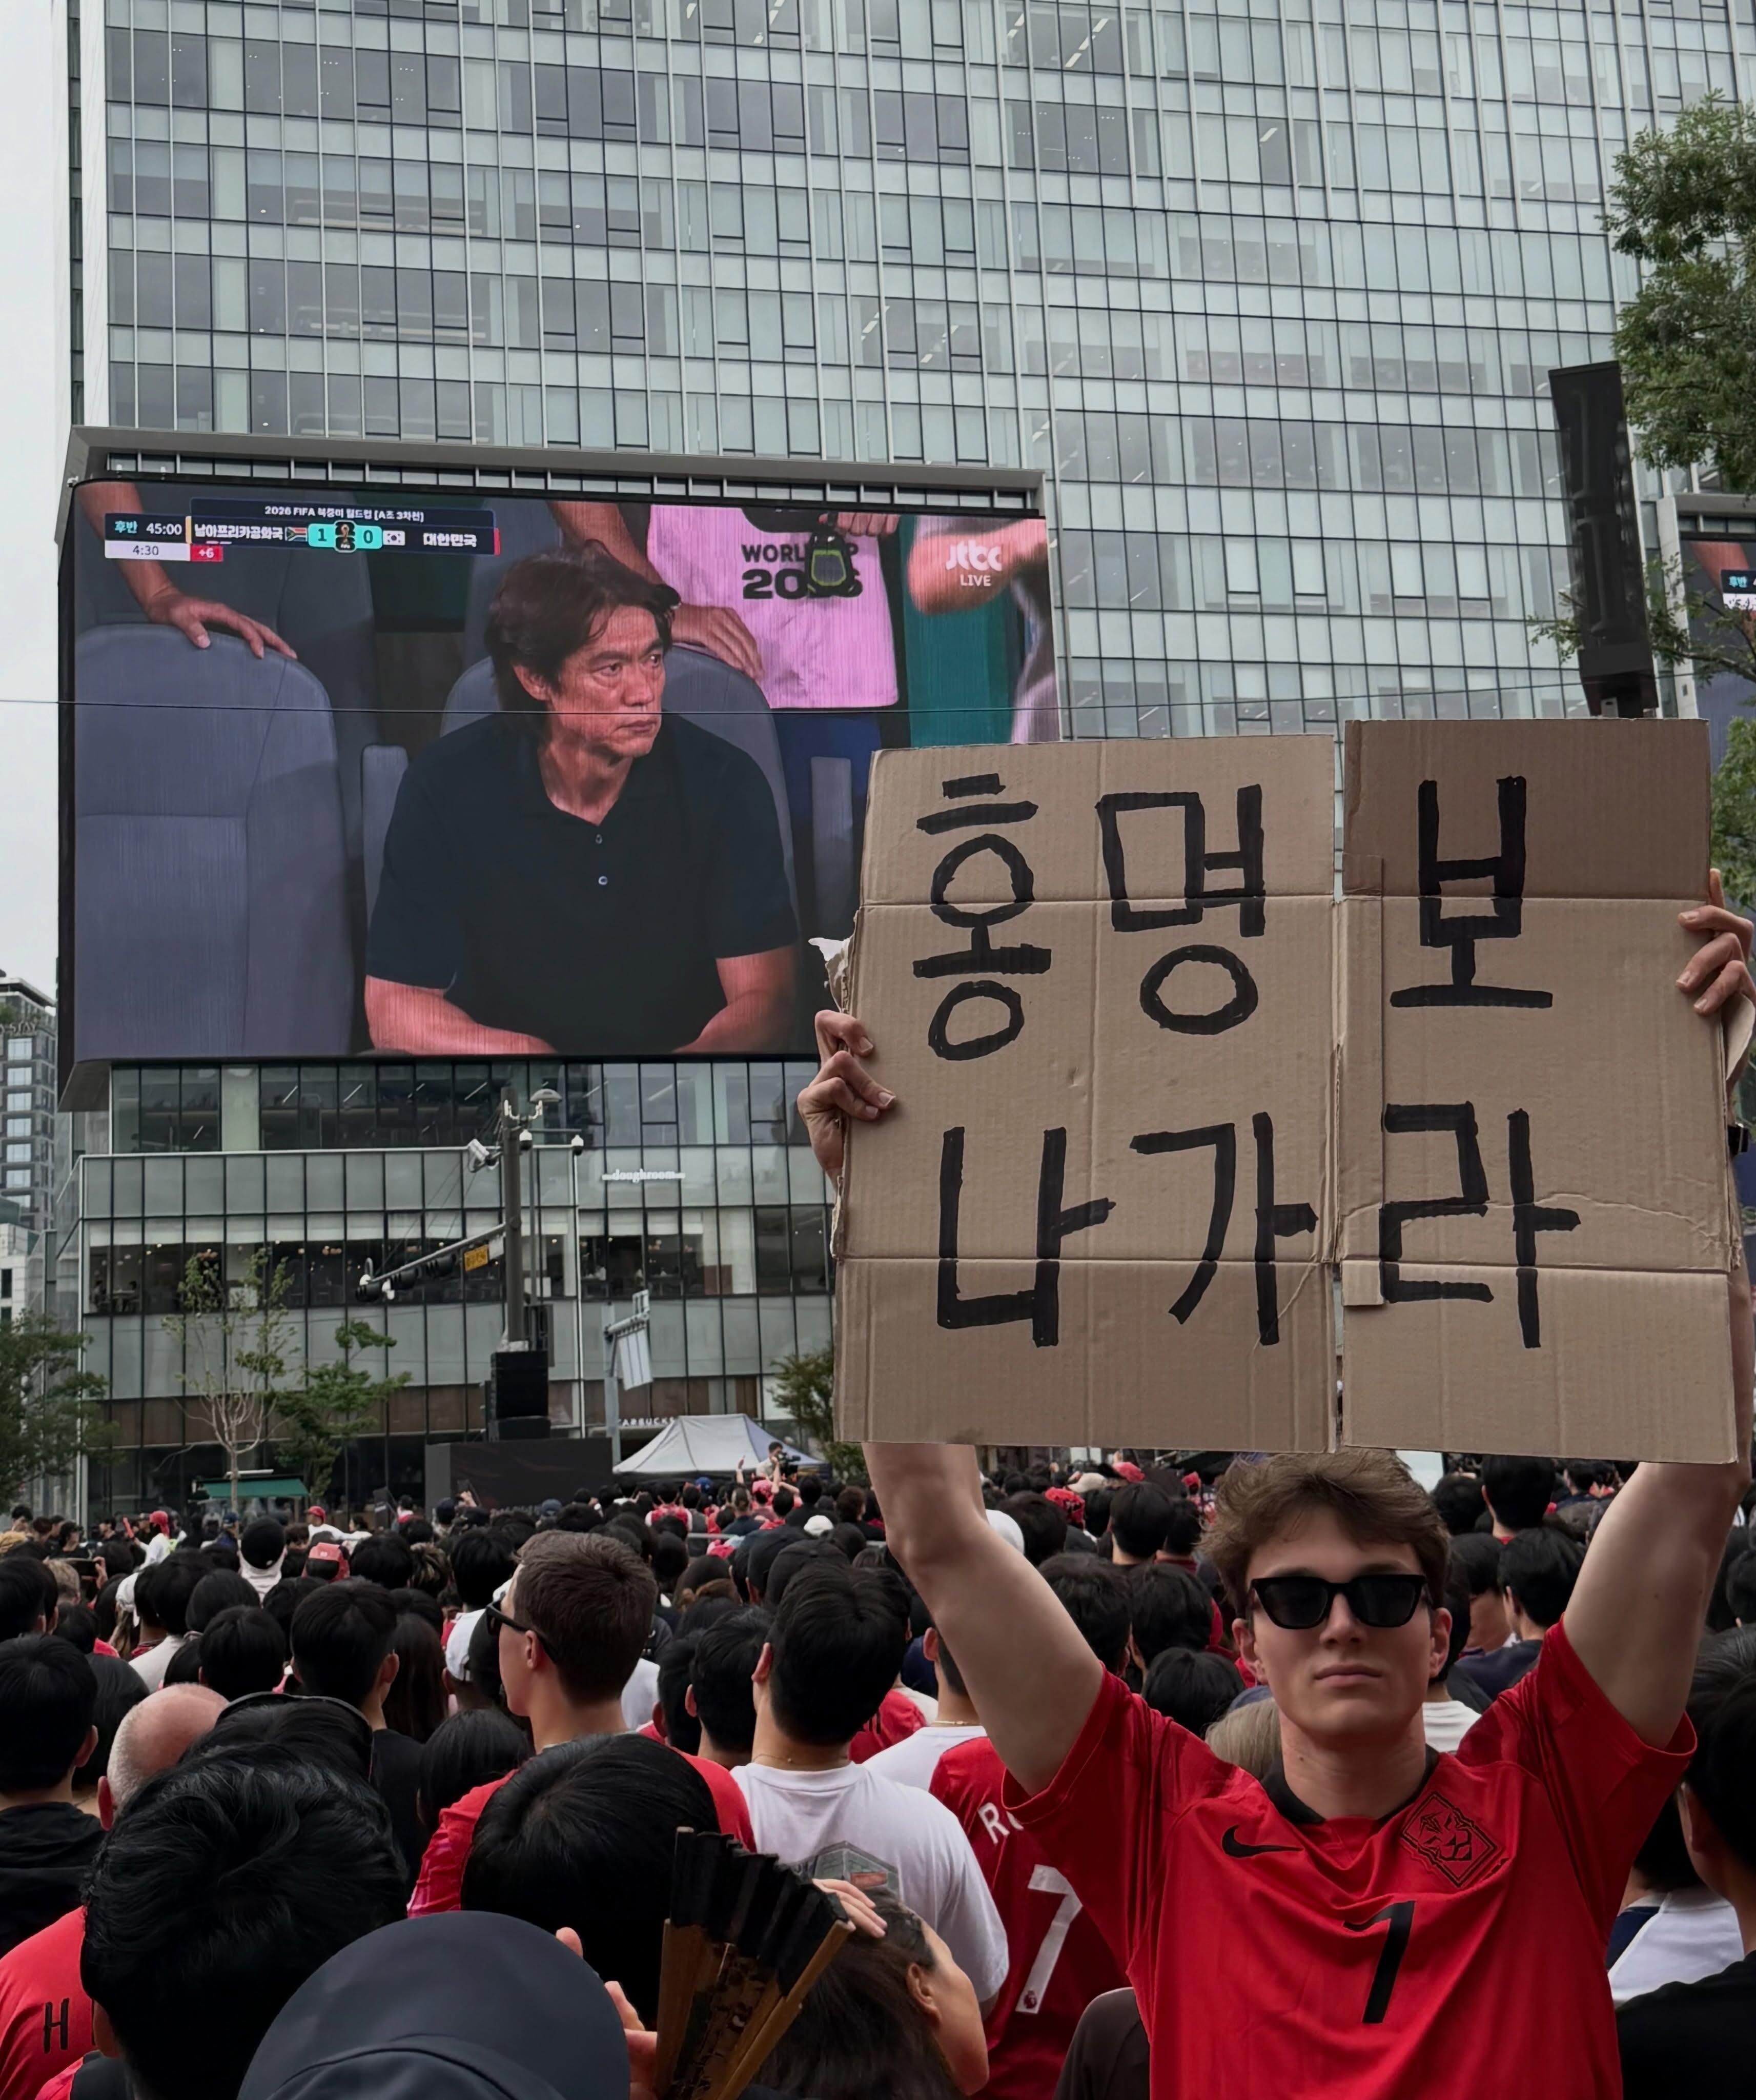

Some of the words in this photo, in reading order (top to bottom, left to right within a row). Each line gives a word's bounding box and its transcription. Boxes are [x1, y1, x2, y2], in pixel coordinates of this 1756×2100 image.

[114, 520, 137, 534] 후반
[146, 522, 182, 535] 45:00
[318, 528, 327, 542] 1
[363, 530, 373, 544] 0
[423, 533, 477, 548] 대한민국
[132, 545, 159, 556] 4:30
[742, 544, 808, 562] WORL
[960, 574, 991, 587] LIVE
[912, 772, 1554, 1061] 홍명보
[937, 1100, 1582, 1348] 나가라
[619, 1417, 674, 1426] ARBUCKS
[1015, 1864, 1083, 2013] 7
